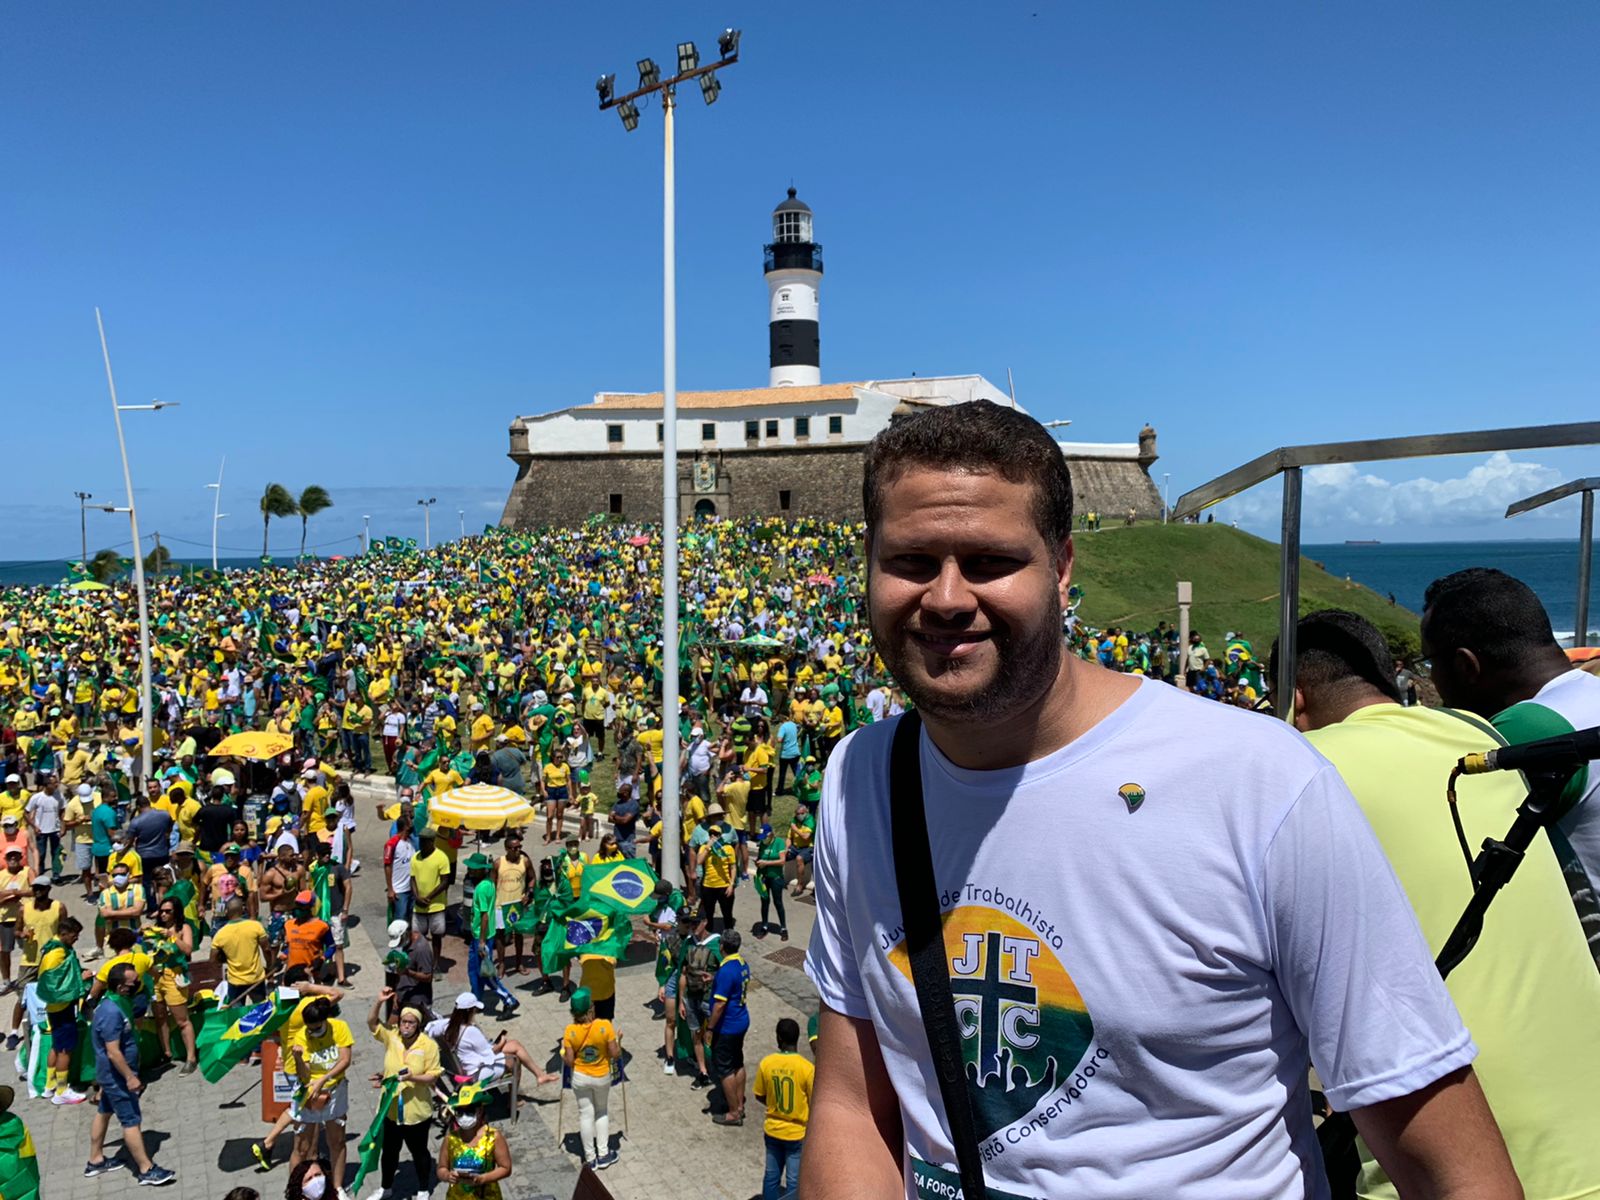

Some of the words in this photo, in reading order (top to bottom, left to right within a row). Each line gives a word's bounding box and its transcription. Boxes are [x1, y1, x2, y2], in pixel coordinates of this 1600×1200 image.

[965, 884, 1063, 950] Trabalhista
[771, 1075, 795, 1115] 10
[979, 1137, 1005, 1162] istã
[1005, 1047, 1110, 1144] Conservadora
